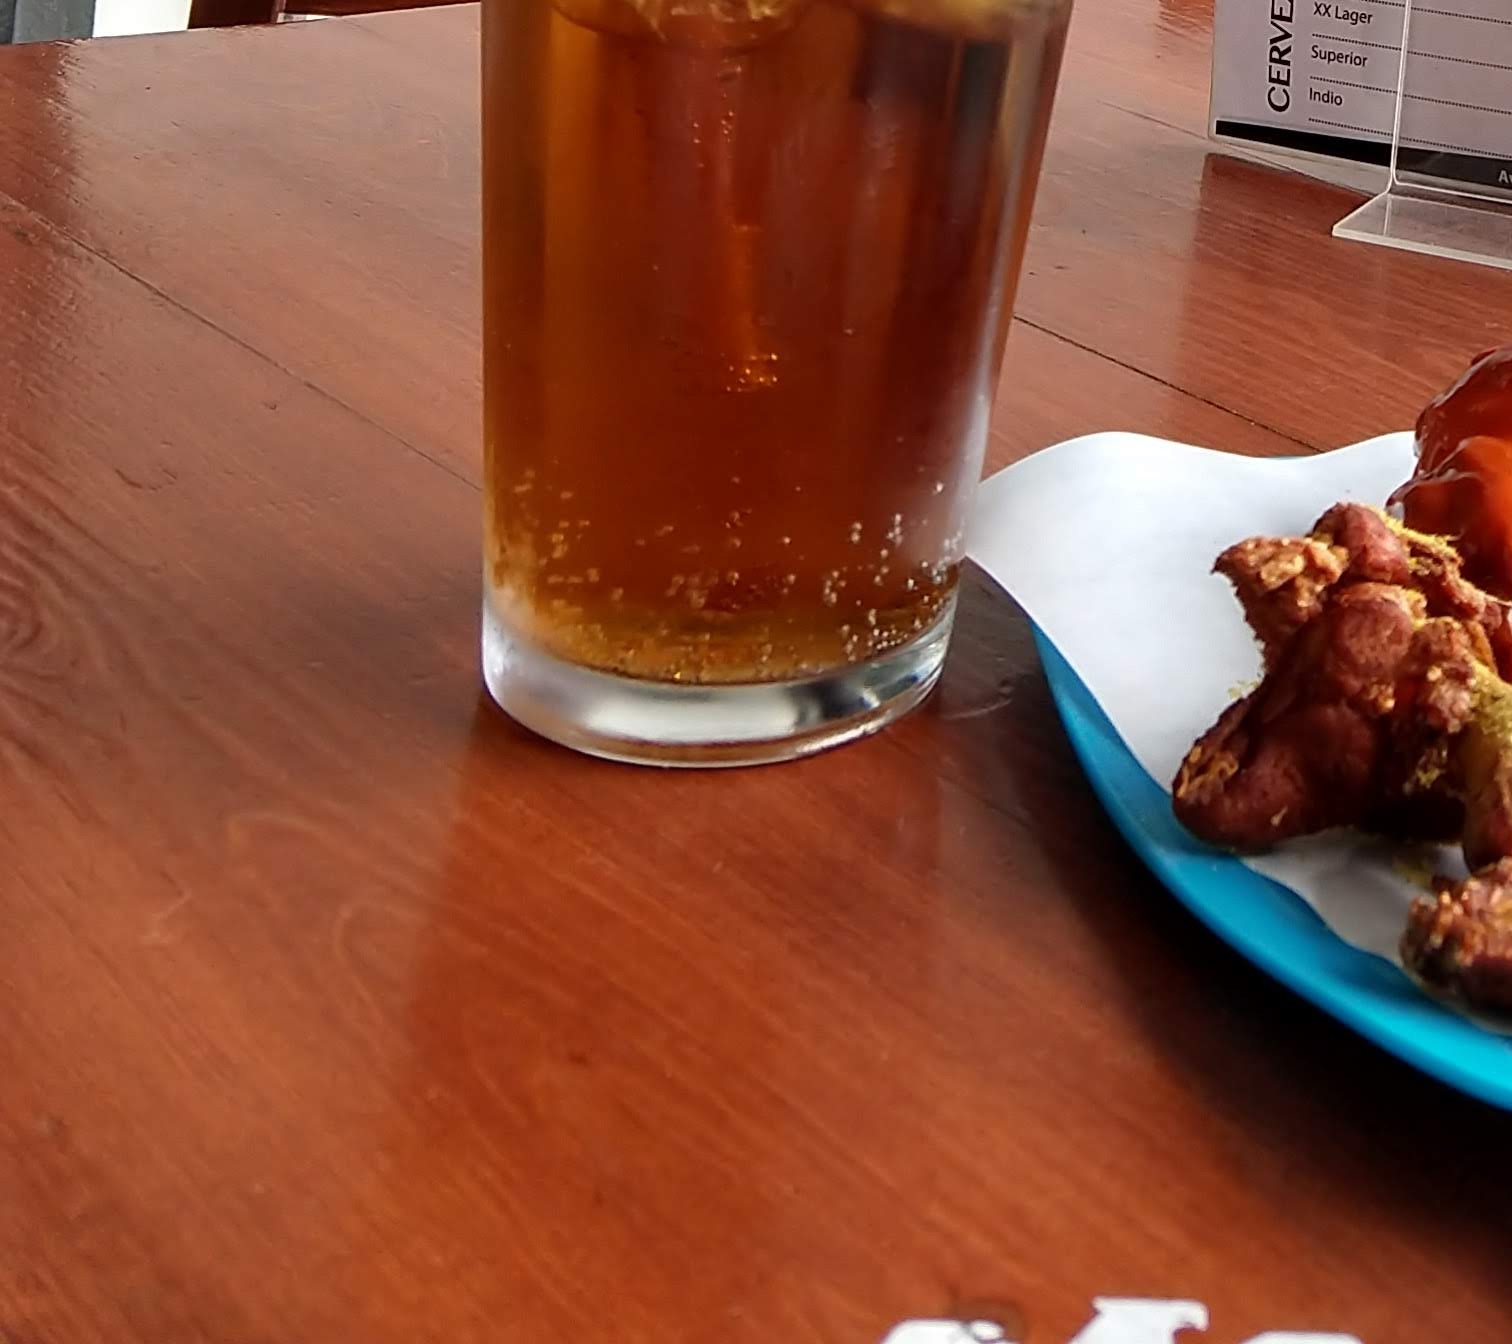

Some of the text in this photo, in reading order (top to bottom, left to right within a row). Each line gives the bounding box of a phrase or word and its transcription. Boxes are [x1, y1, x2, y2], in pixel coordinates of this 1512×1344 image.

[1312, 1, 1374, 26] XX Lager
[1309, 44, 1369, 70] Superior
[1308, 87, 1344, 108] Indio
